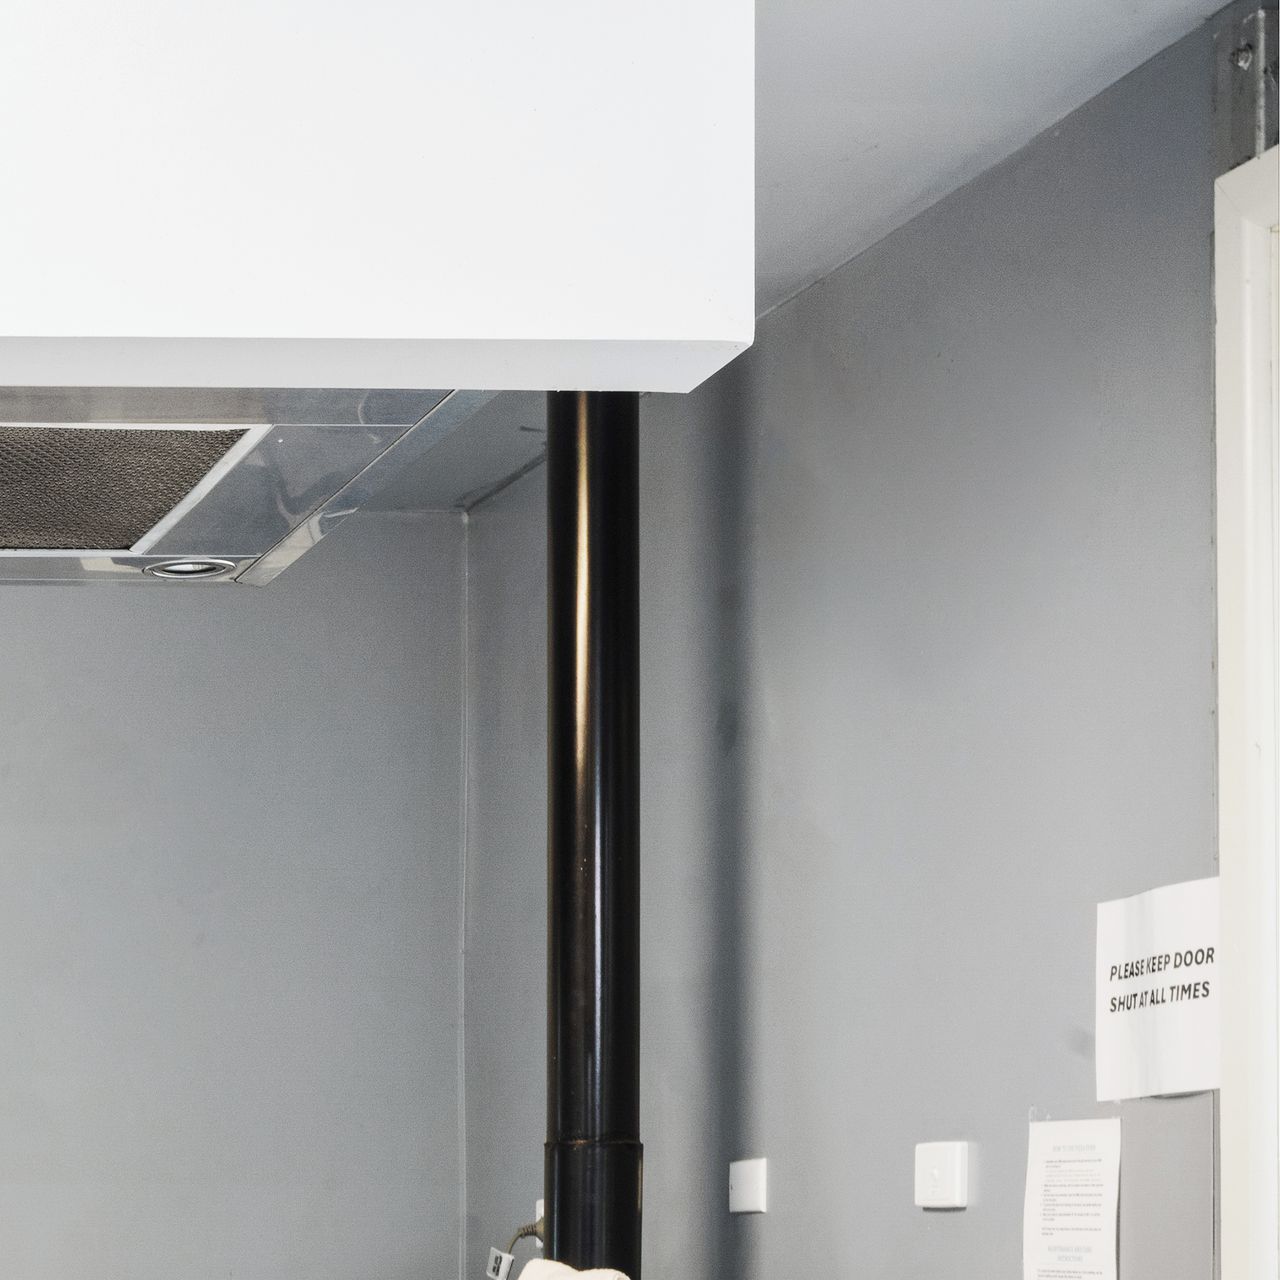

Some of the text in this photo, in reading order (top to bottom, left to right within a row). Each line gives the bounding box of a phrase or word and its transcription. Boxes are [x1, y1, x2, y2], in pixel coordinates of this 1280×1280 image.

[1109, 946, 1215, 982] PLEASE KEEP DOOR
[1109, 980, 1211, 1013] SHUT AT ALL TIMES
